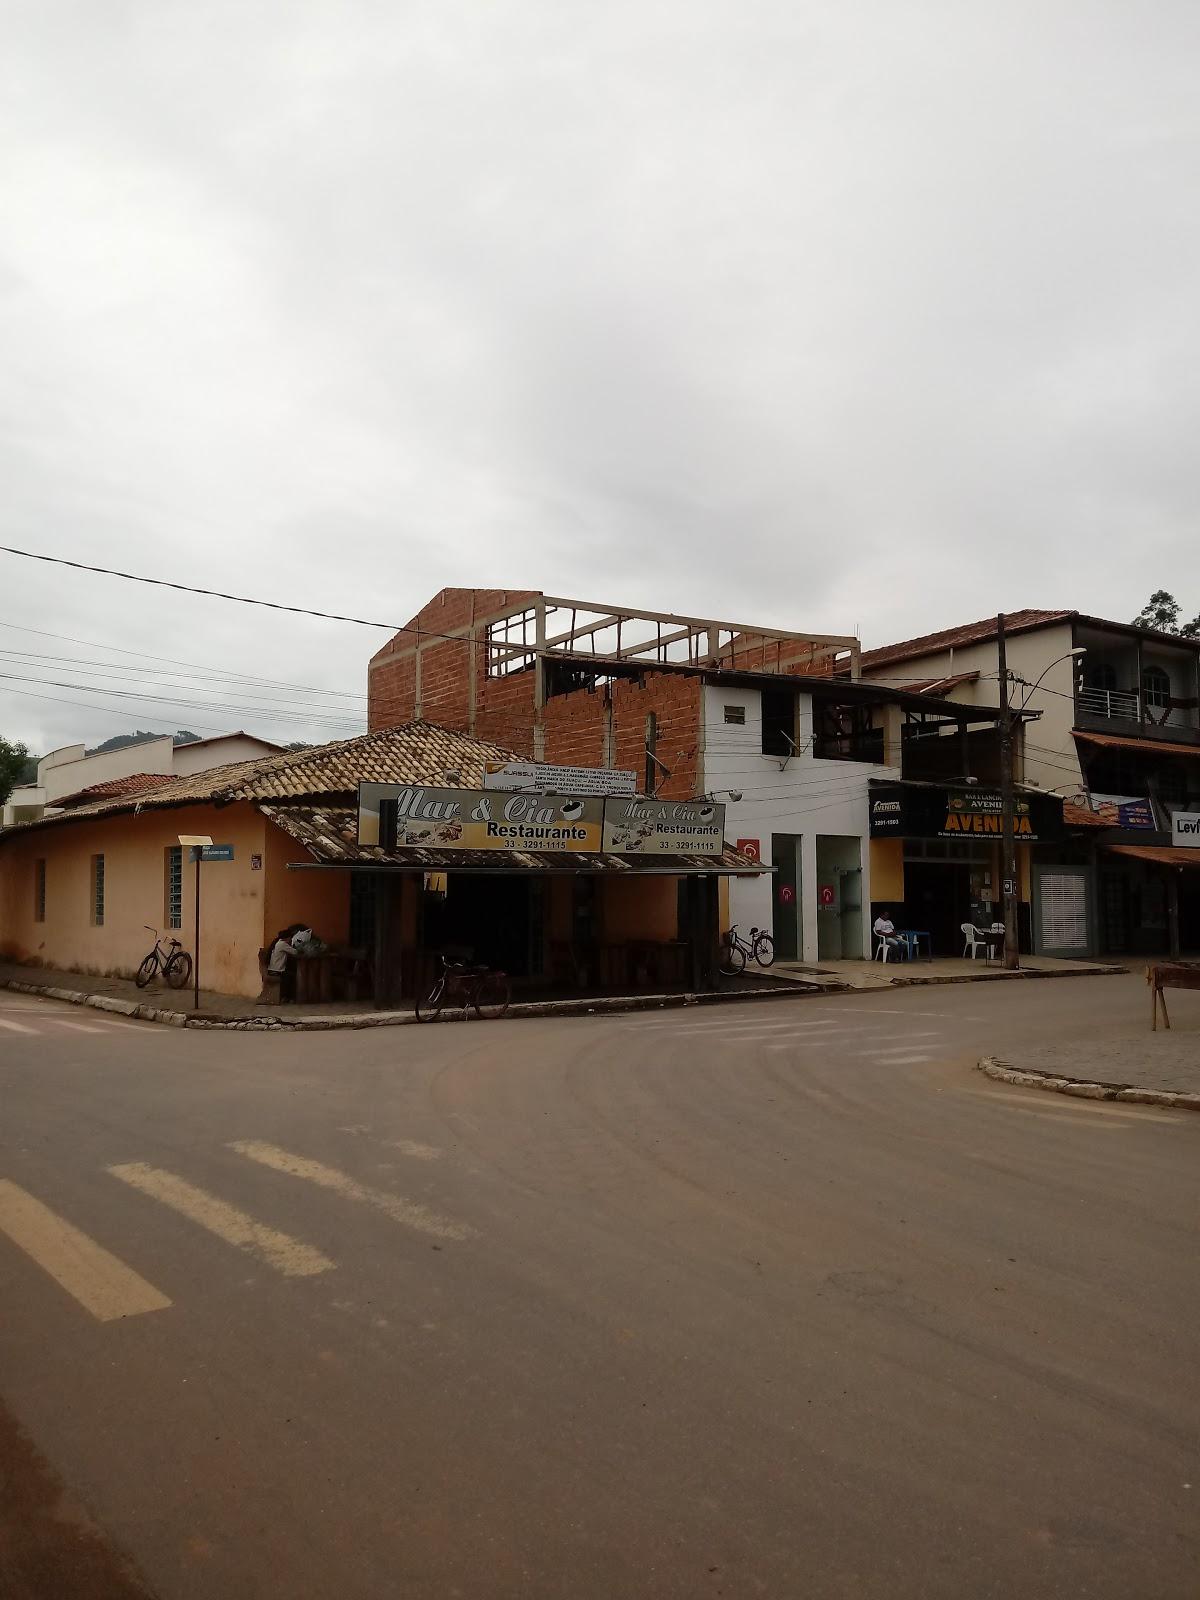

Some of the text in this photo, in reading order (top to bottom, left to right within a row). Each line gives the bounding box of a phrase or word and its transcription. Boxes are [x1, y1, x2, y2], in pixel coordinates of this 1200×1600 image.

[471, 798, 492, 821] &
[504, 795, 556, 824] Cia
[622, 803, 696, 821] Mar & Cia
[487, 821, 587, 840] Restaurante
[656, 823, 719, 835] Restaurante
[504, 839, 516, 848] 33
[523, 840, 566, 849] 3291-1115
[660, 841, 669, 849] 33
[676, 841, 714, 850] 3291-1115
